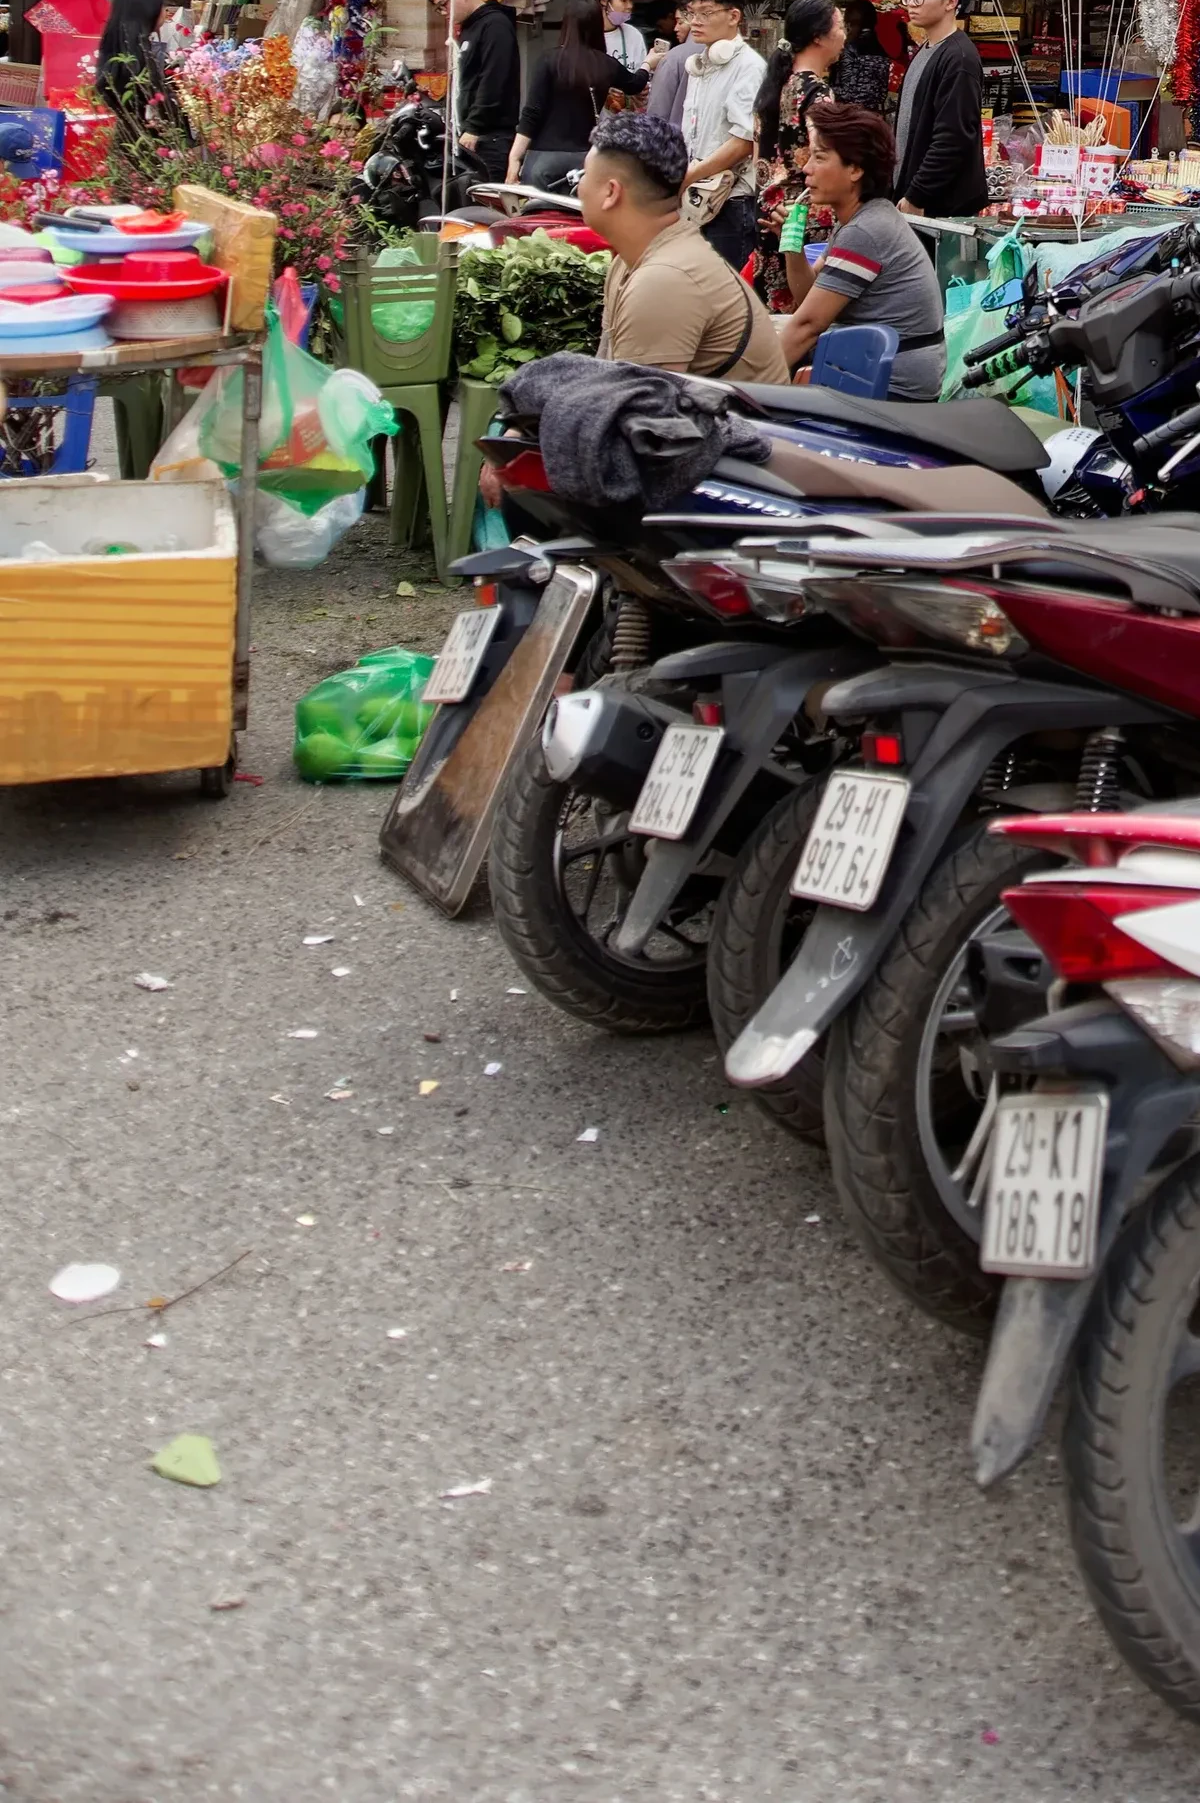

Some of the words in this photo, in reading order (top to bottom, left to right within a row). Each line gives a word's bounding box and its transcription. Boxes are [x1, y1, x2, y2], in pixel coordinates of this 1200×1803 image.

[824, 782, 892, 838] 29-H1
[800, 837, 878, 899] 997.64
[1004, 1110, 1083, 1180] 29-K1
[995, 1189, 1084, 1260] 186.18
